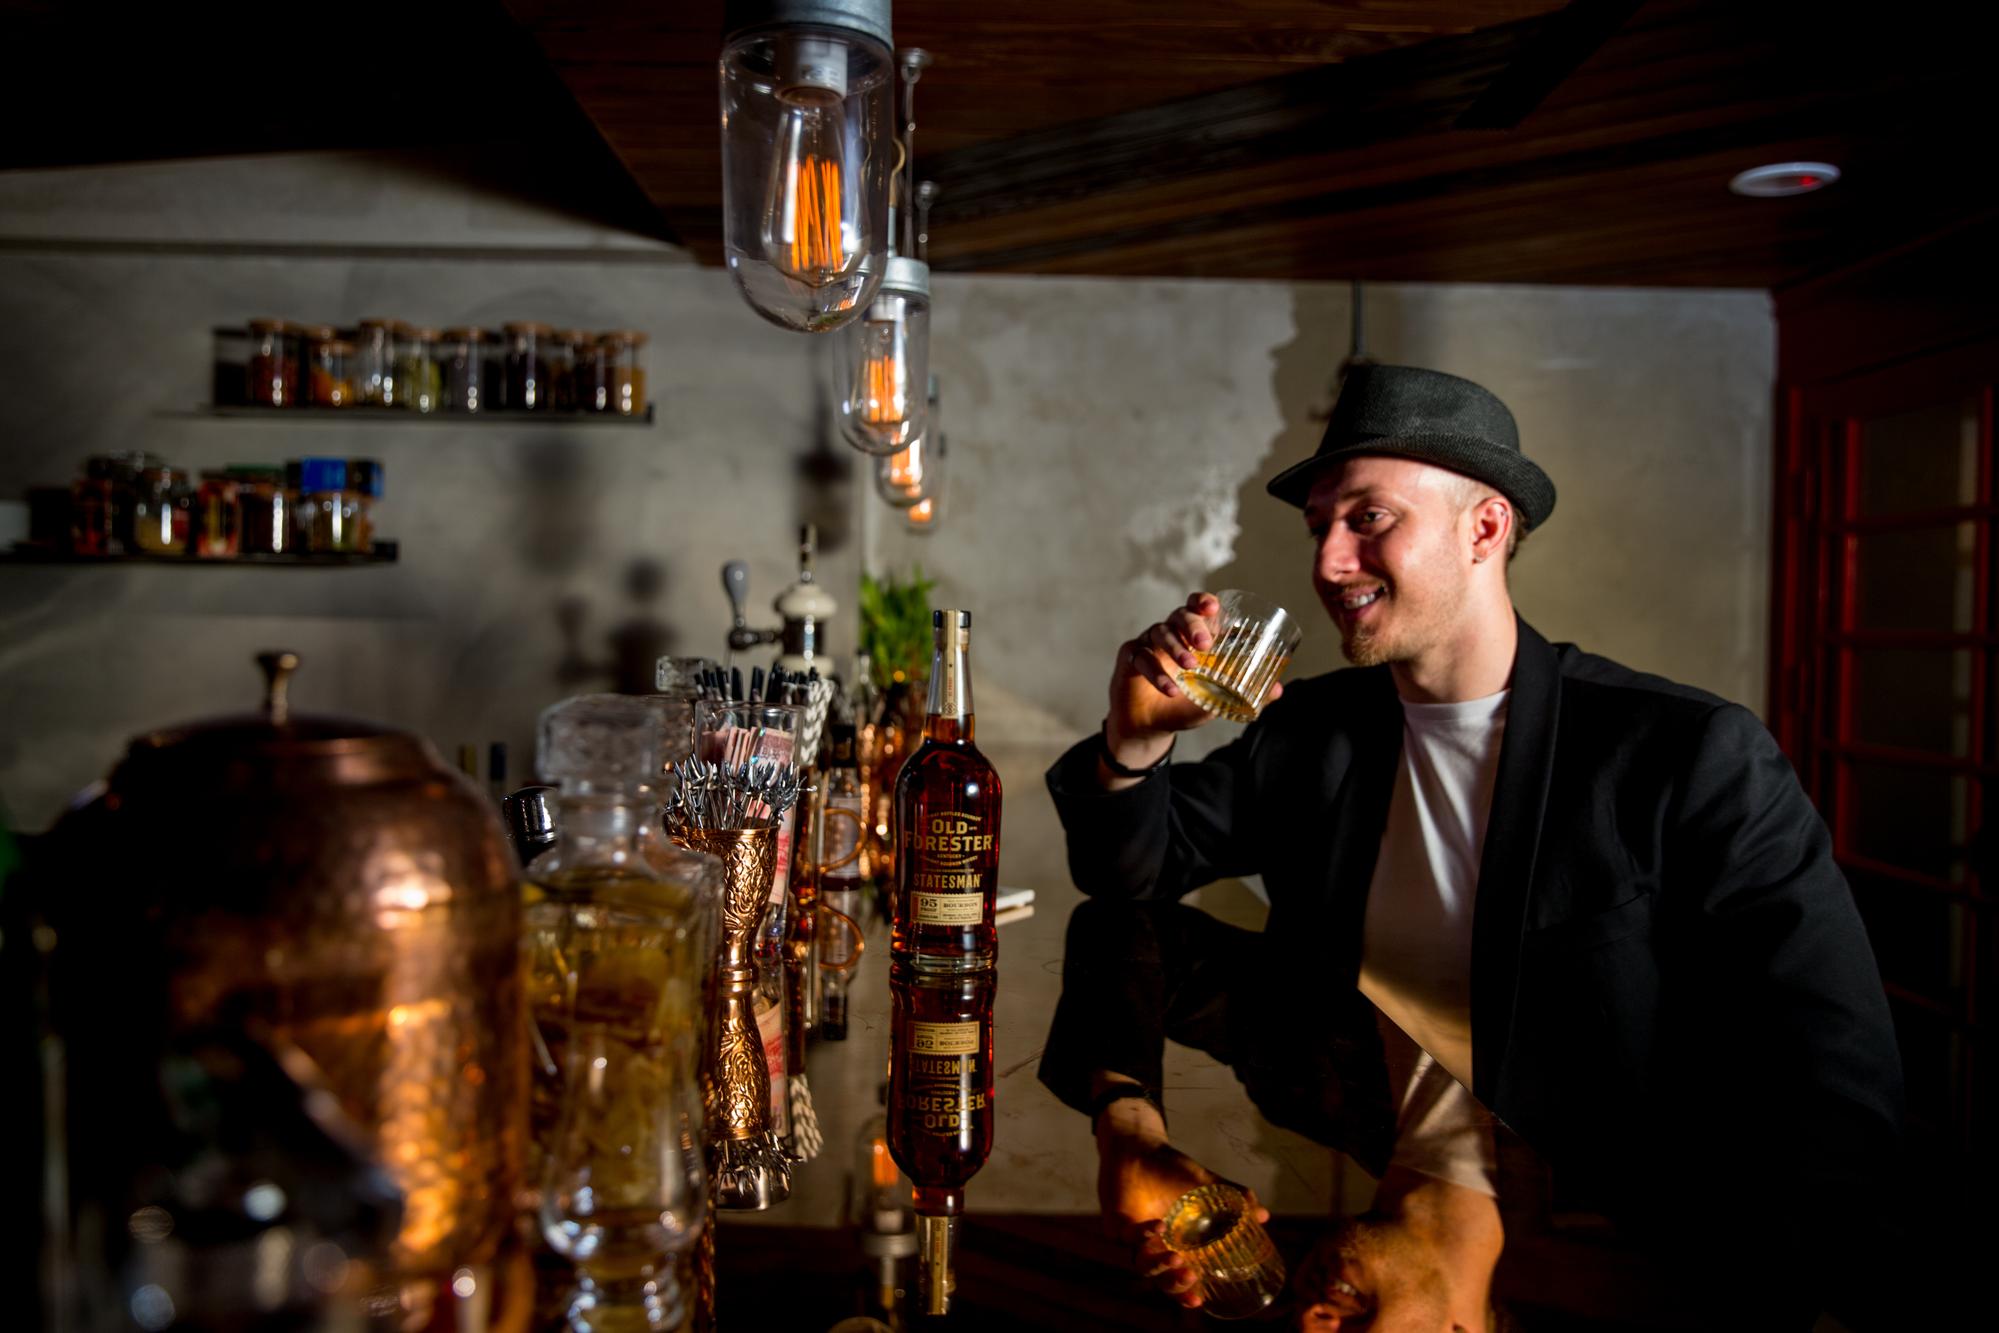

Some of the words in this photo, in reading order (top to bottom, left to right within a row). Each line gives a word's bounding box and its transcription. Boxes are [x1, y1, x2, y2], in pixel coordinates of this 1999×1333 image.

[931, 818, 968, 835] OLD
[904, 830, 993, 852] FORESTER
[913, 873, 981, 889] STATESMAN
[920, 898, 937, 907] 95
